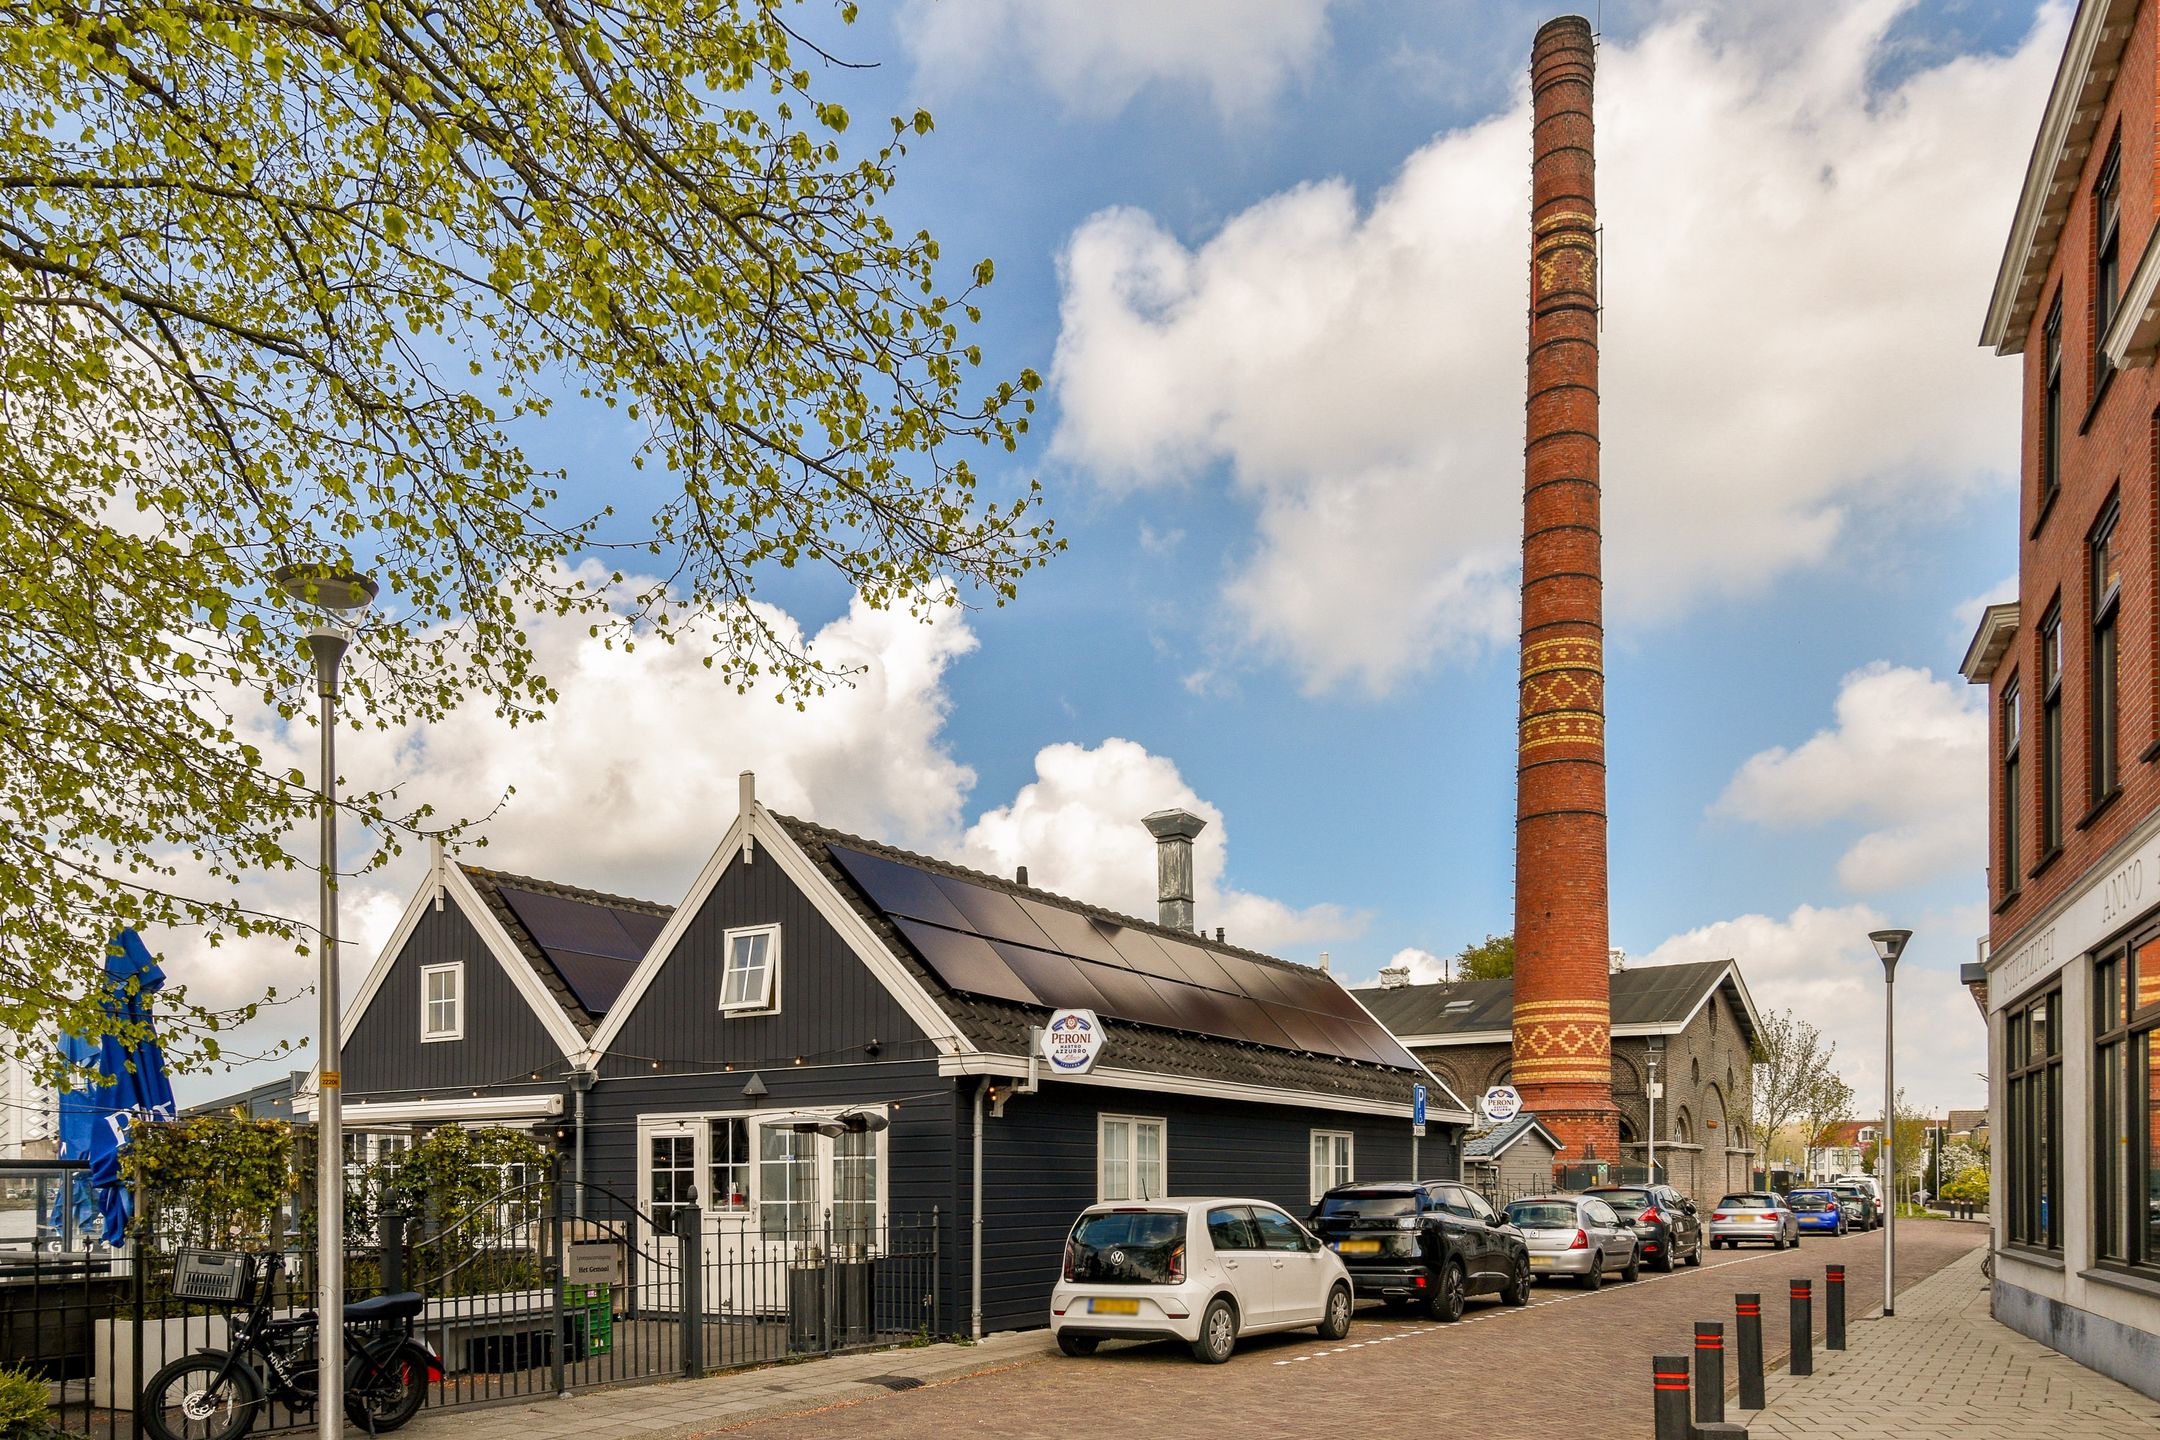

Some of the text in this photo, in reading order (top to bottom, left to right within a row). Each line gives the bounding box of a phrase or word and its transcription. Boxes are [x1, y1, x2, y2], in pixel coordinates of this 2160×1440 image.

[2003, 927, 2055, 994] SUIKERZICHT
[2102, 858, 2142, 923] ANNO
[1051, 1033, 1091, 1044] PERONI
[1418, 1088, 1424, 1108] P
